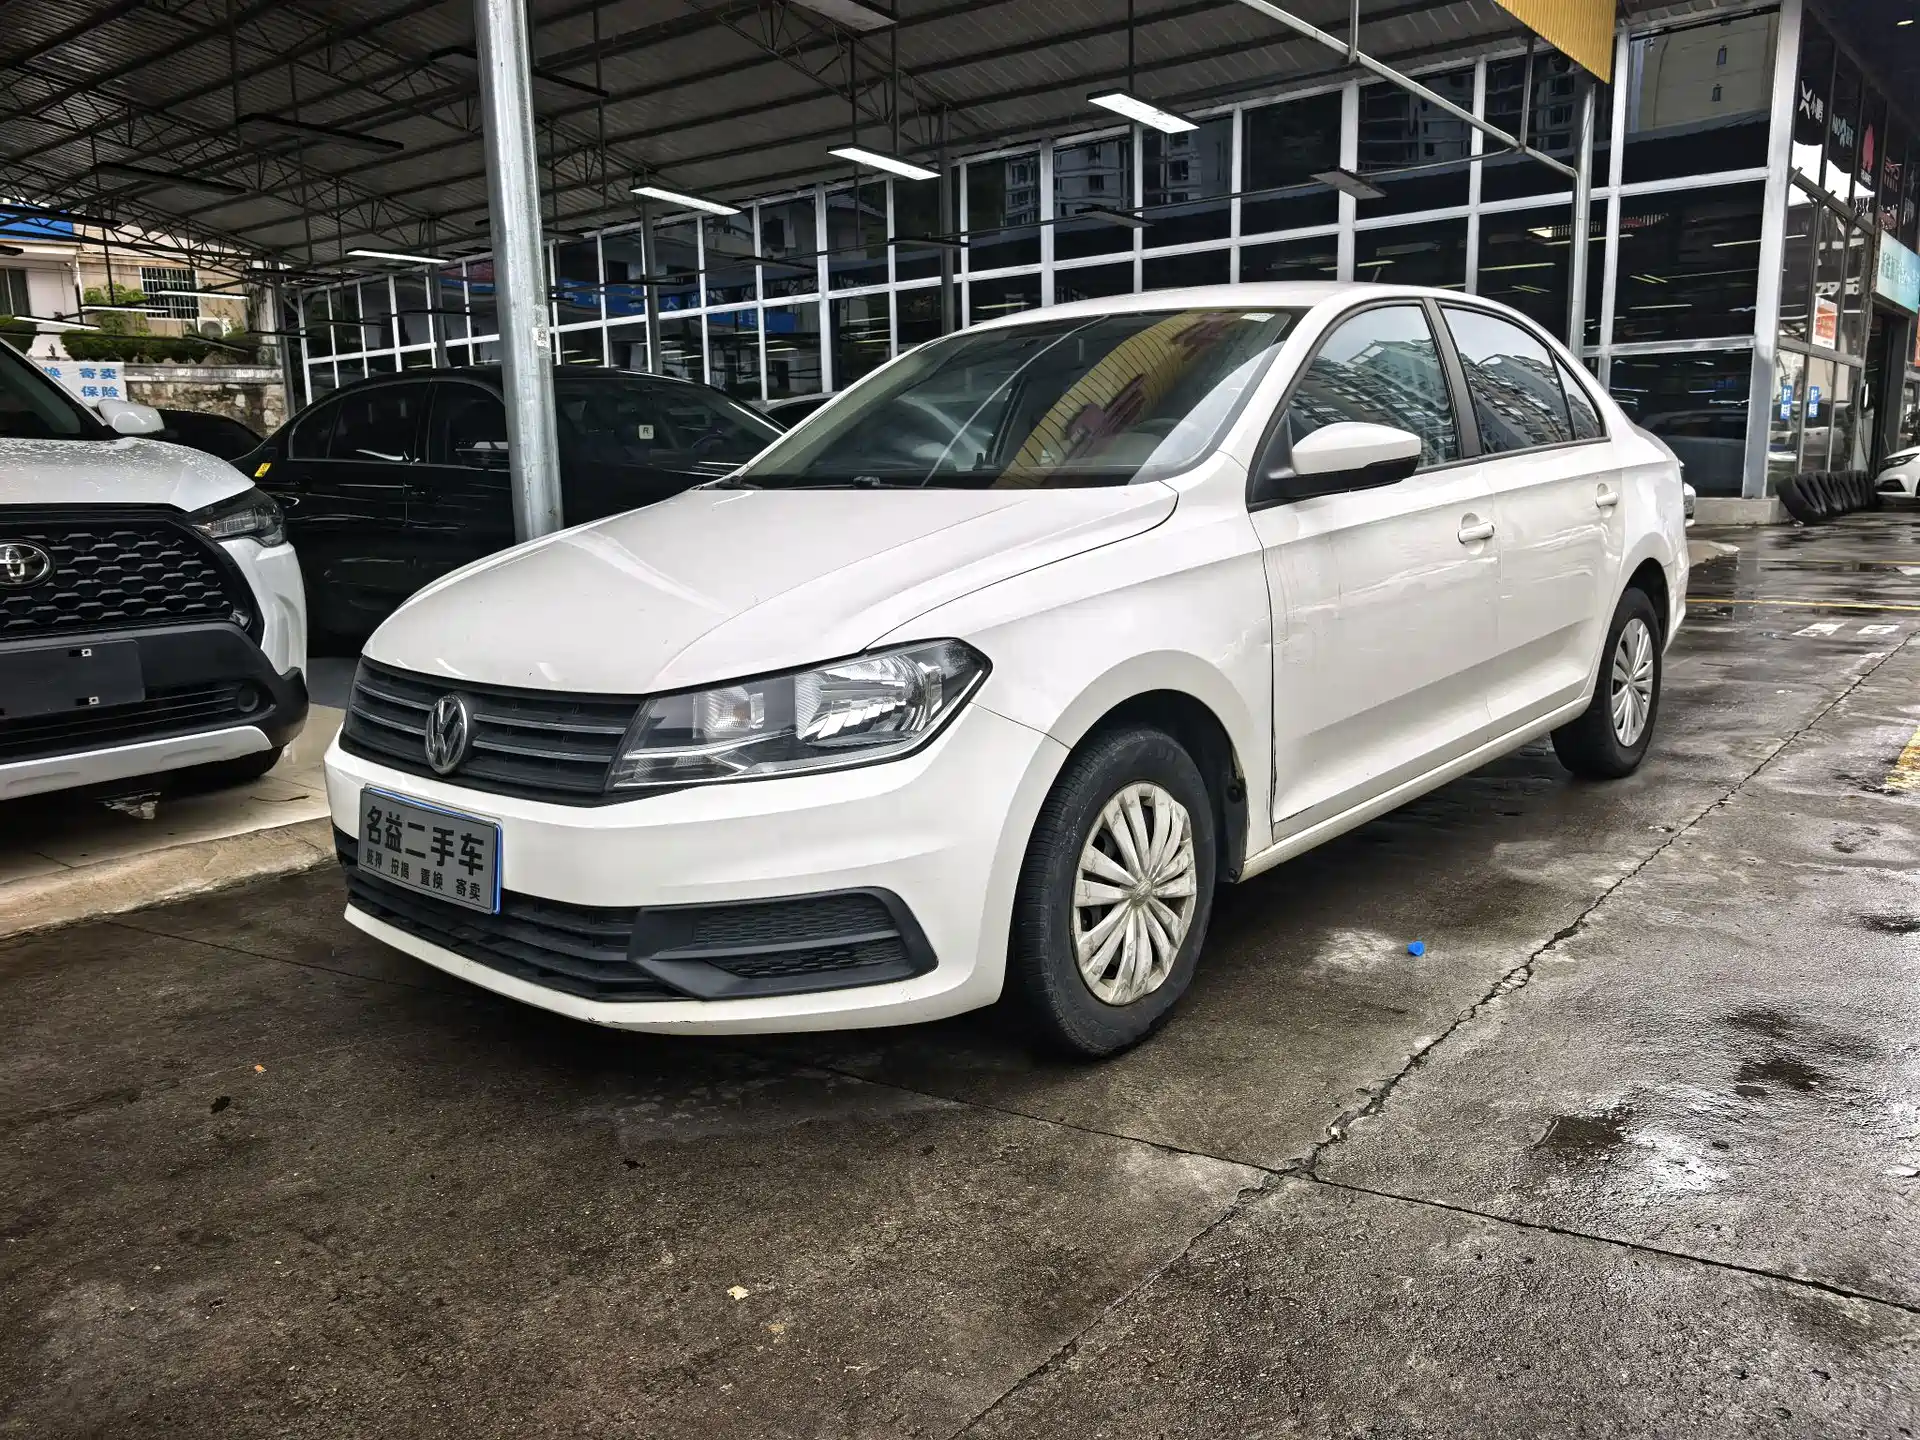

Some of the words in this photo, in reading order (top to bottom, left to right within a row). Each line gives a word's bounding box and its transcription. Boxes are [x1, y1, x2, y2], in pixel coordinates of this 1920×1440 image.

[79, 367, 117, 380] 寄卖
[81, 385, 120, 398] 保险
[366, 806, 485, 877] 名益二手车
[420, 867, 443, 891] 置换
[455, 878, 481, 901] 寄卖
